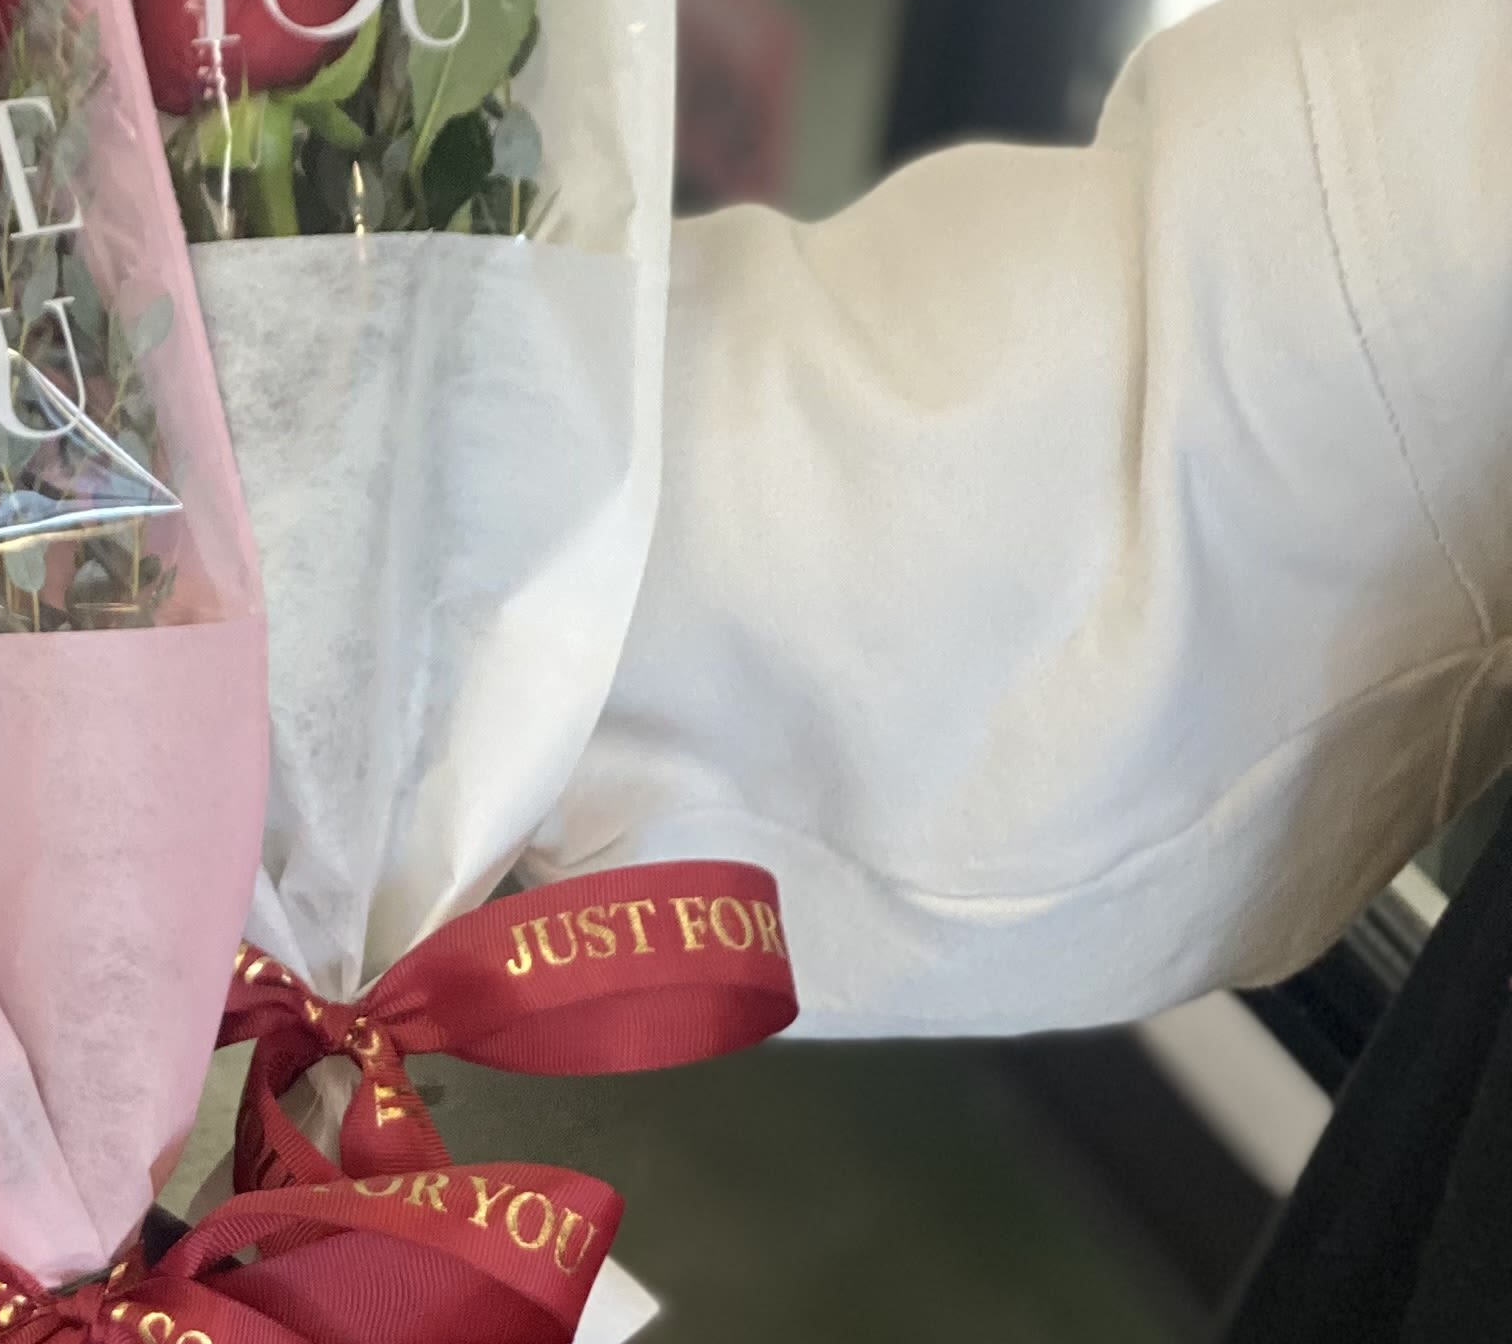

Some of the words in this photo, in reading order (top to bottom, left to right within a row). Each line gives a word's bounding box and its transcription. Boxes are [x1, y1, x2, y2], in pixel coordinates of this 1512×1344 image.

[505, 898, 656, 978] JUST
[669, 894, 787, 960] FOR
[470, 1174, 598, 1275] YOU
